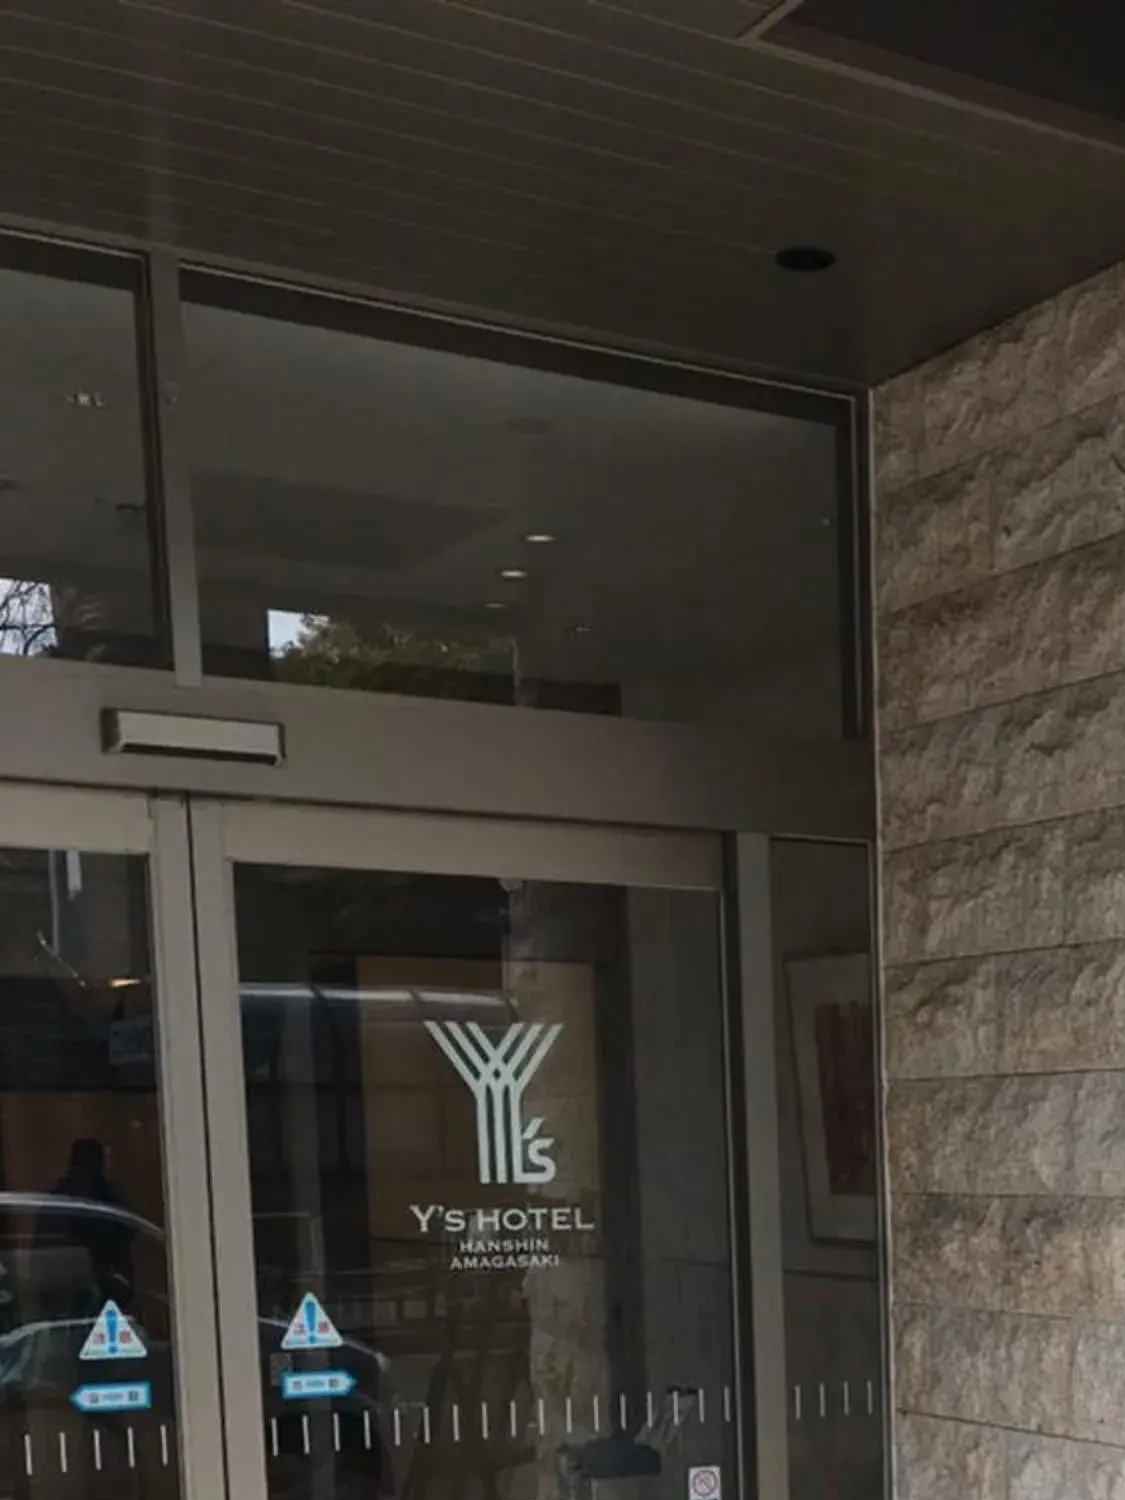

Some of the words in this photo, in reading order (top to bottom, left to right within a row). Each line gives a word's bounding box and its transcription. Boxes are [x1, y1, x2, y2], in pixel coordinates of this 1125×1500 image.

[477, 1207, 595, 1233] HOTEL
[459, 1238, 549, 1254] HANSHIN
[450, 1253, 560, 1271] AMAGASAKI
